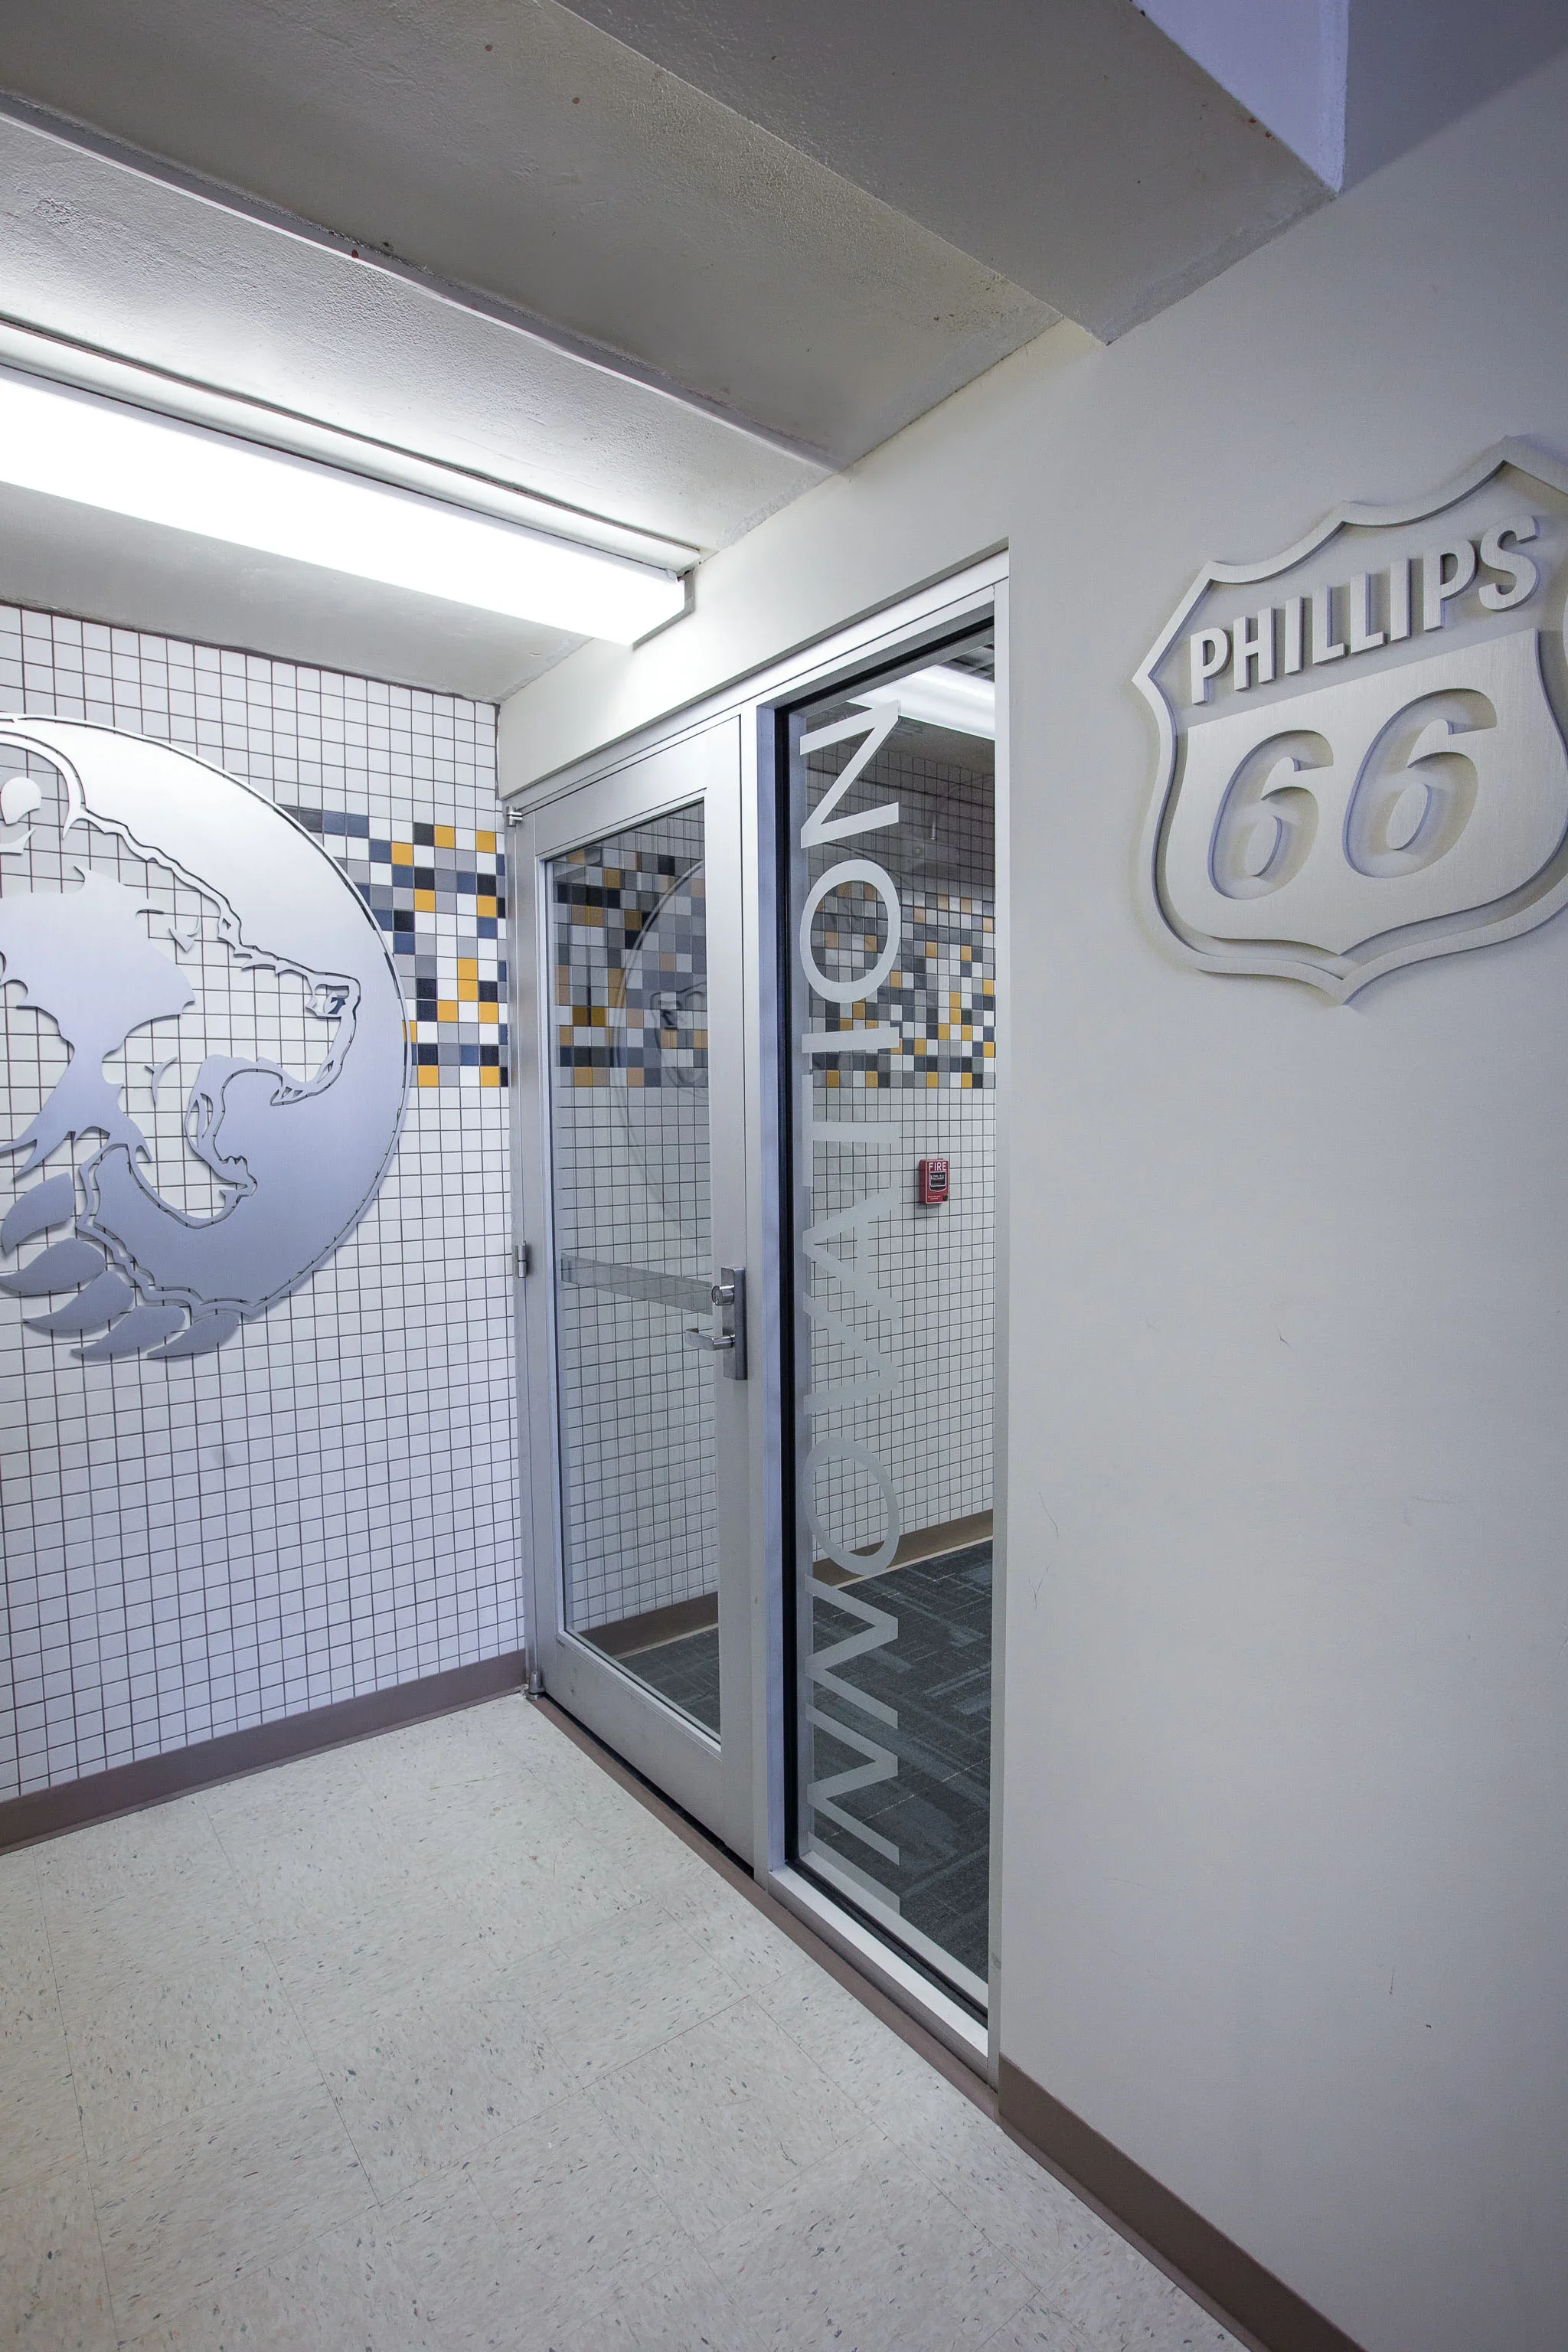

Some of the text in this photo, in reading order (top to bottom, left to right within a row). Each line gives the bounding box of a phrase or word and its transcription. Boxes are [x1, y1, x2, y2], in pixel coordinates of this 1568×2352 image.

[1190, 514, 1540, 706] PHILLIPS
[1207, 688, 1498, 900] 66
[929, 1161, 947, 1171] FIRE
[799, 699, 901, 1916] INNOVATION
